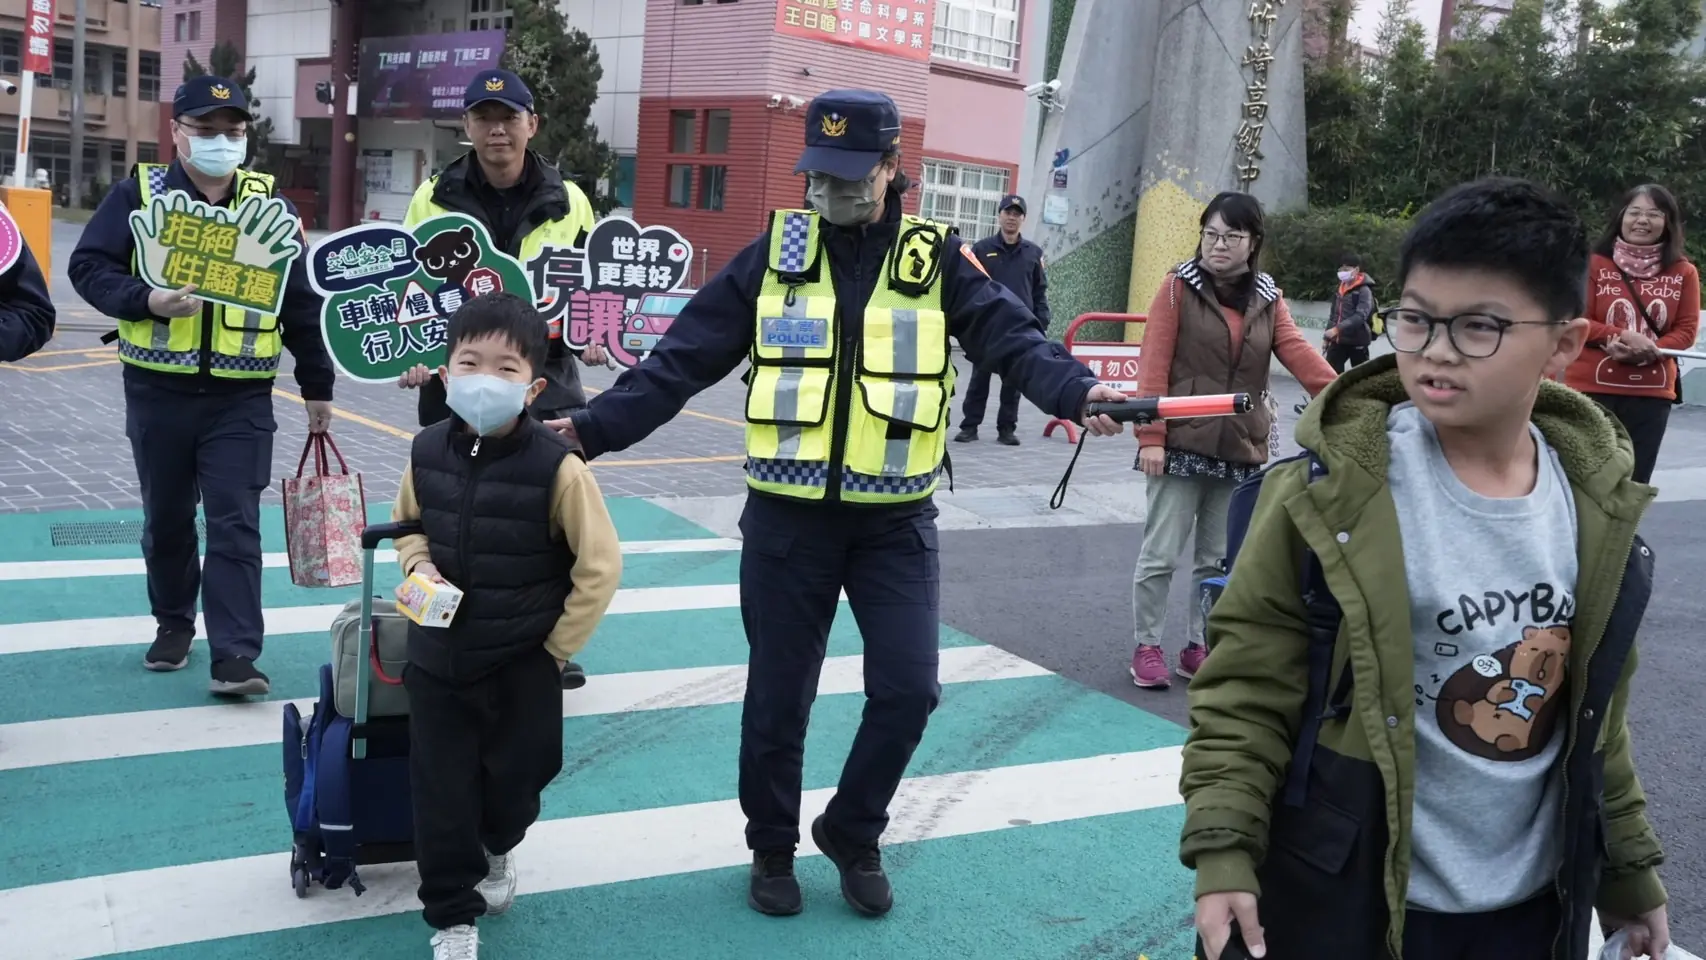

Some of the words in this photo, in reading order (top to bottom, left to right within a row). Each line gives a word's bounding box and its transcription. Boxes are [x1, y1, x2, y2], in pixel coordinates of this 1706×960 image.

[1235, 0, 1286, 193] 竹崎高級中
[162, 213, 238, 258] 拒絕
[611, 236, 660, 262] 世界
[166, 251, 278, 306] 性騷擾
[597, 262, 672, 289] 更美好
[569, 289, 640, 367] 讓
[767, 332, 820, 344] POLICE
[1088, 360, 1121, 377] 請勿
